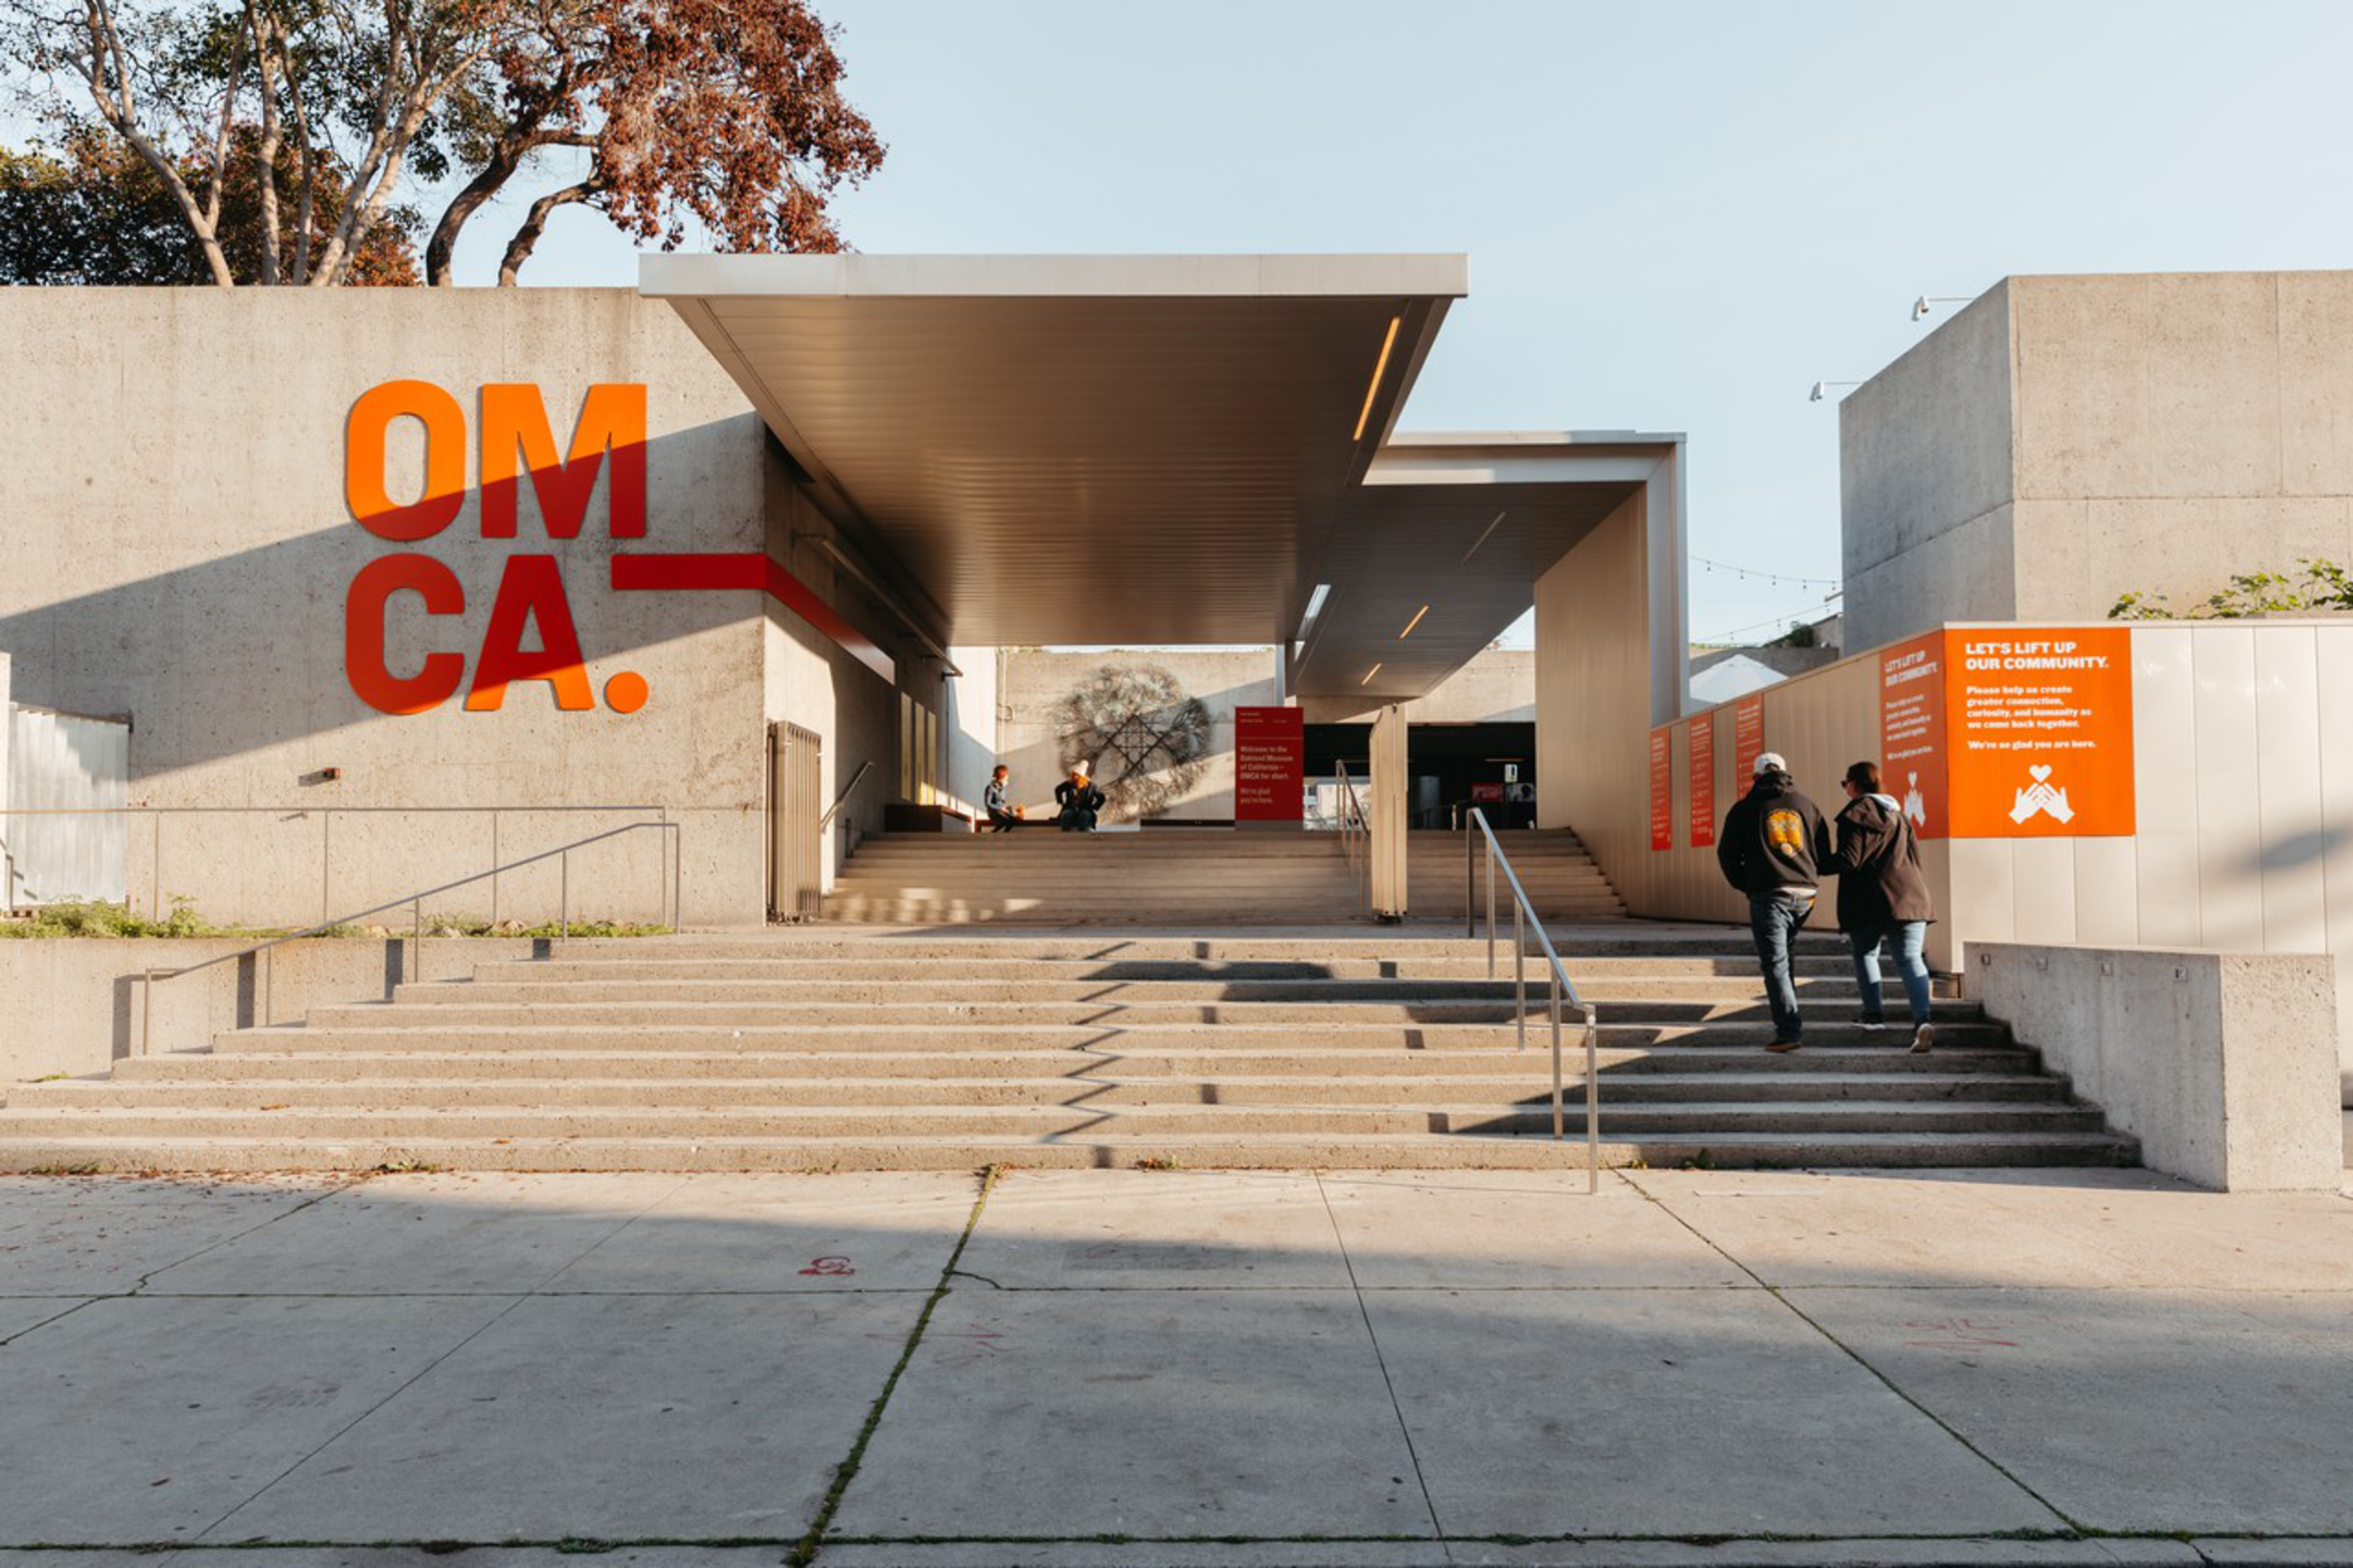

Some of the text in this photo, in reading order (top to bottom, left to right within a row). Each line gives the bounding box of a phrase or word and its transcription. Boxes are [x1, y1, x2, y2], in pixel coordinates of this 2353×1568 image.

[344, 379, 647, 541] OM
[344, 553, 648, 714] CA.
[1965, 642, 2076, 654] LET'S LIFT UP
[1965, 656, 2109, 669] OUR COMMUNITY.
[2003, 686, 2024, 695] help
[1966, 698, 2003, 707] greater
[1967, 709, 2011, 718] curiosity,
[2036, 719, 2079, 729] together.
[1968, 740, 1996, 749] We're
[2012, 741, 2033, 750] glad
